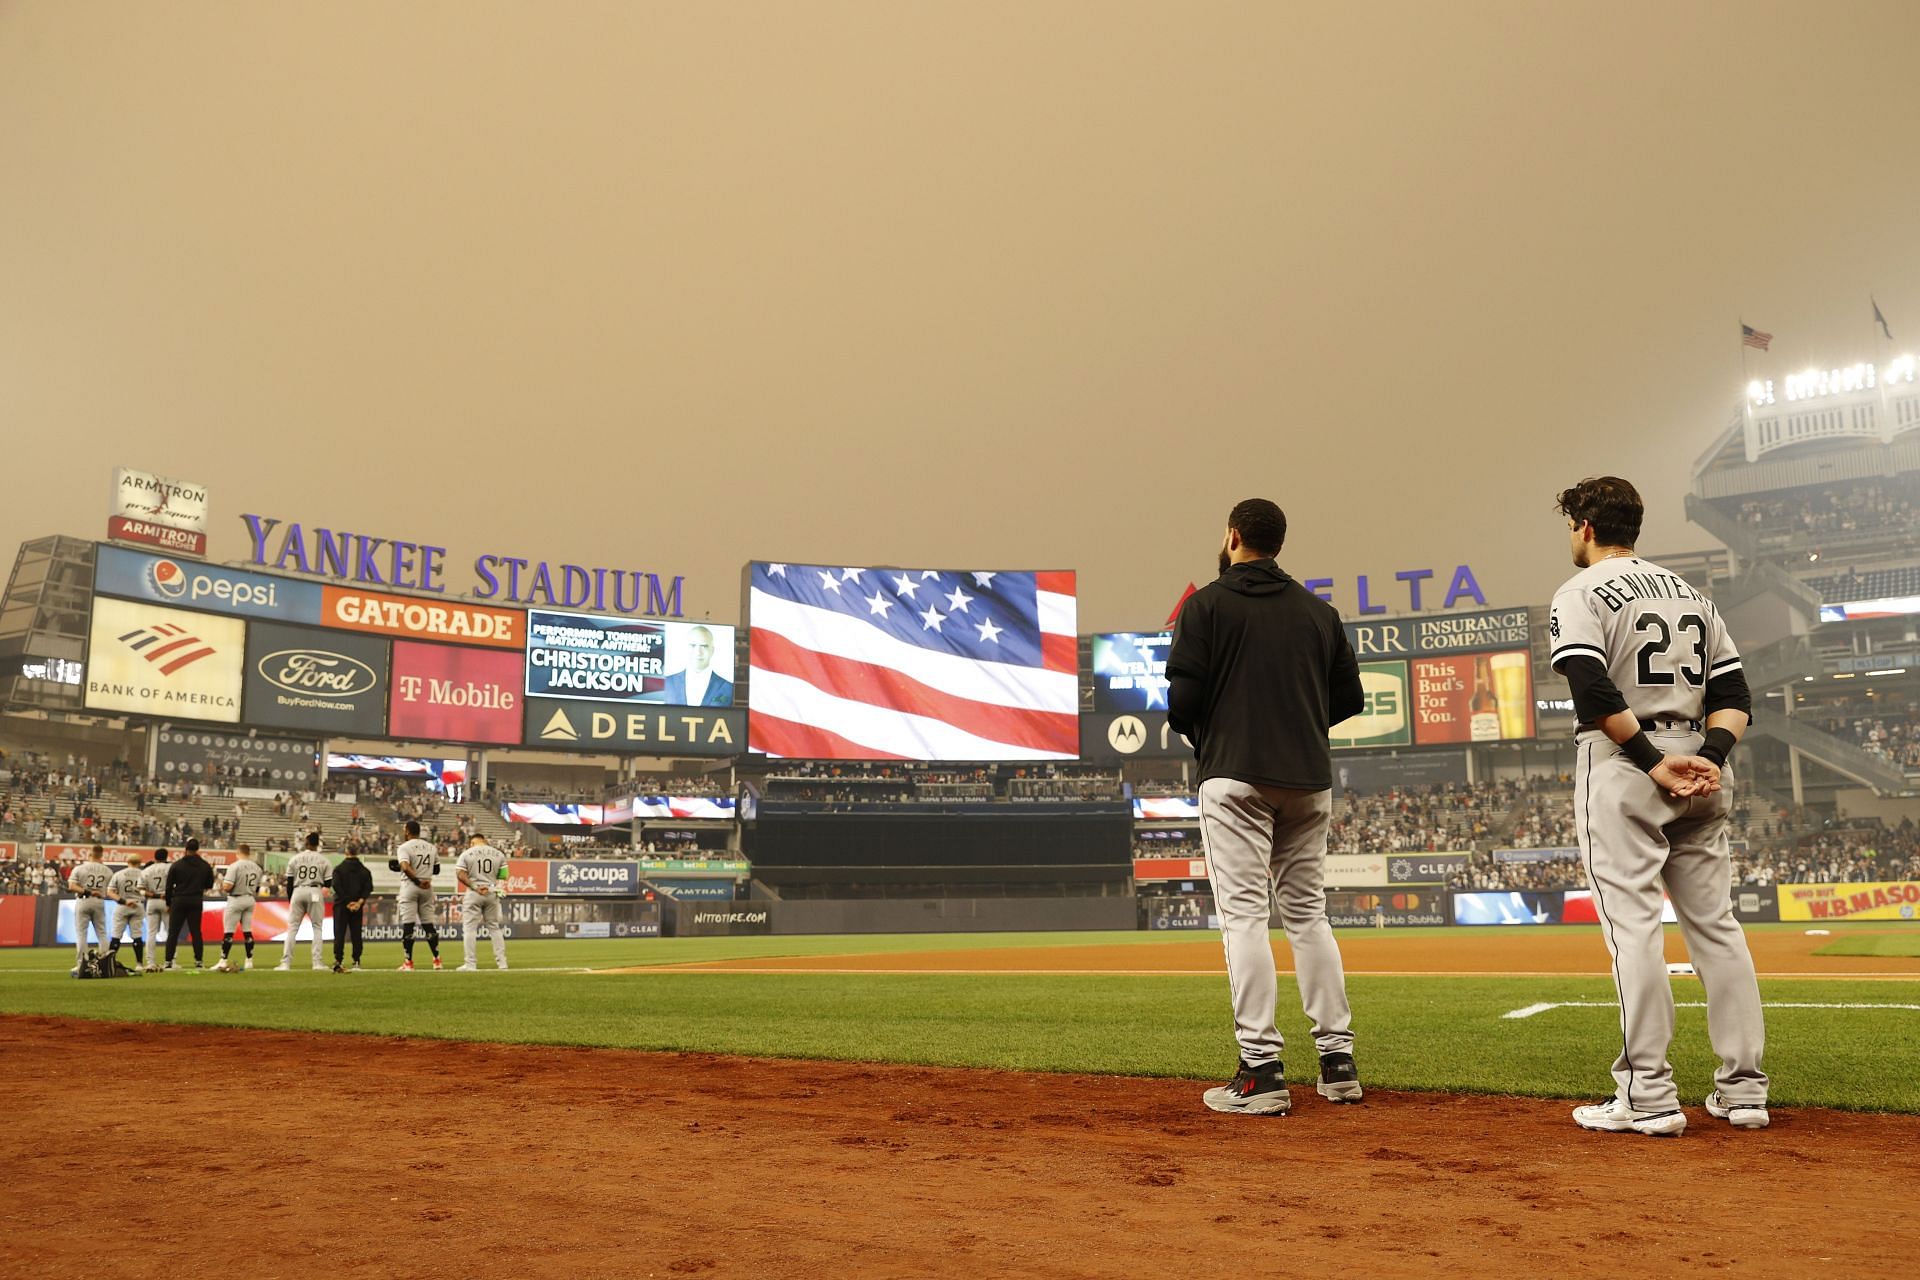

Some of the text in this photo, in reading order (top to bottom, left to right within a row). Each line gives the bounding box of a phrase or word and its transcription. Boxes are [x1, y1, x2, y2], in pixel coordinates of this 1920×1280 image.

[122, 475, 205, 502] ARMITRON
[122, 520, 198, 545] ARMITRON
[239, 513, 685, 617] YANKEE STADIUM
[192, 575, 276, 607] pepsi
[1592, 573, 1716, 620] BENINTE
[335, 596, 513, 641] GATORADE
[1421, 612, 1528, 635] INSURANCE
[533, 624, 663, 645] PERFORMING TONIGHT'S
[545, 635, 600, 649] NATIONAL
[1421, 627, 1529, 649] COMPANIES
[1634, 612, 1707, 687] 23
[531, 648, 663, 675] CHRISTOPHER
[1416, 663, 1456, 678] This
[279, 654, 357, 691] Ford
[548, 668, 643, 692] JACKSON
[90, 681, 235, 708] BANK OF AMERICA
[400, 675, 514, 710] T Mobile
[1418, 678, 1465, 693] Bud's
[1419, 694, 1448, 709] For
[1419, 709, 1457, 724] You.
[592, 712, 734, 744] DELTA
[299, 865, 318, 880] 88
[416, 854, 431, 870] 74
[477, 858, 492, 874] 10
[1419, 862, 1465, 874] CLEAR
[86, 874, 105, 888] 32
[154, 877, 162, 890] 7
[245, 873, 257, 887] 12
[579, 867, 629, 885] coupa
[694, 912, 767, 924] NITTOTIRE.COM
